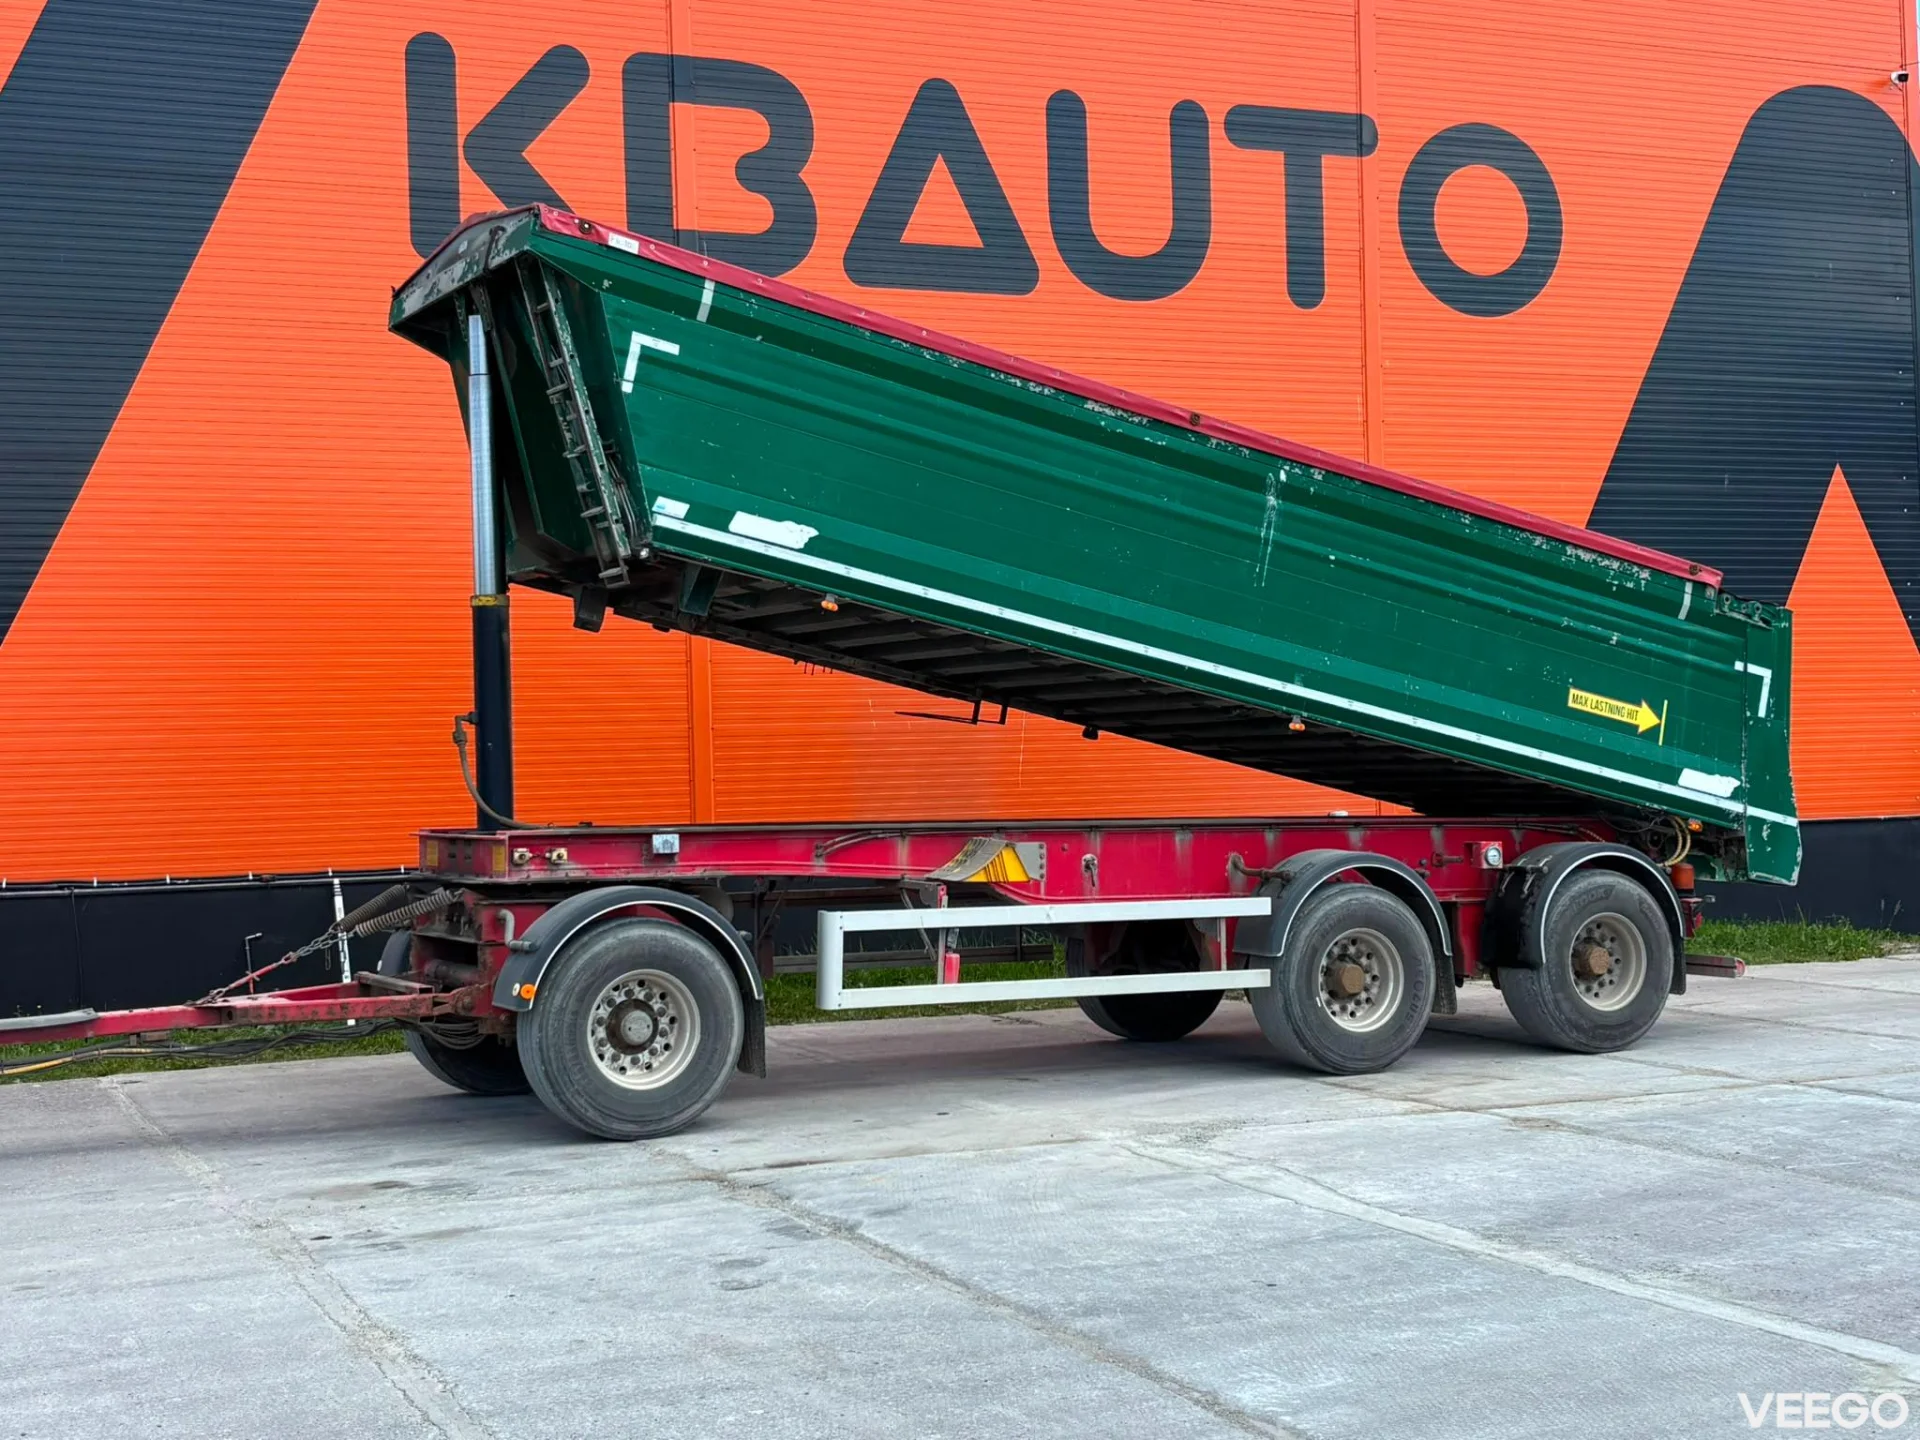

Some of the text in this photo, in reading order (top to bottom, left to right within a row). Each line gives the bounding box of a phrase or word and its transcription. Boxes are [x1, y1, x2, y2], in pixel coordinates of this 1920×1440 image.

[1571, 692, 1639, 721] MAX LASTNING HIT
